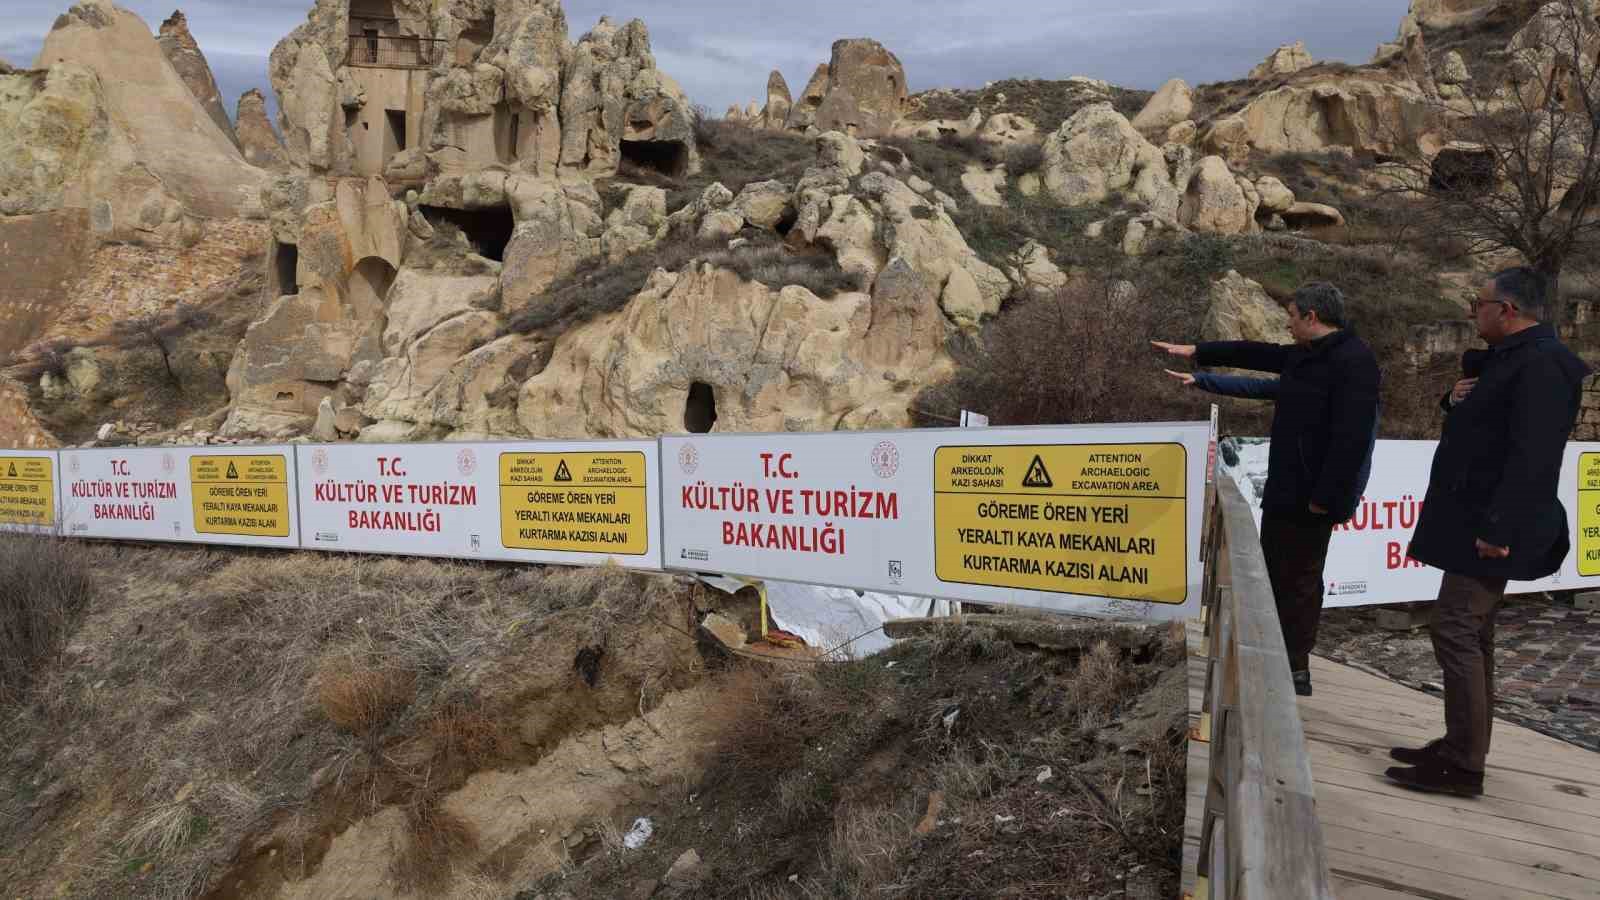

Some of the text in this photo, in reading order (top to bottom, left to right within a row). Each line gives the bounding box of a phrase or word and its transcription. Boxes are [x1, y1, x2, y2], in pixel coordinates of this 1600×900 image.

[110, 460, 131, 476] T.C.
[377, 457, 406, 476] T.C.
[760, 453, 799, 478] T.C.
[962, 453, 993, 464] DİKKAT
[1088, 453, 1142, 464] ATTENTION
[950, 465, 1004, 475] ARKEOLOJİK
[1080, 467, 1150, 478] ARCHAELOGIC
[71, 479, 177, 499] KÜLTÜR VE TURİZM
[315, 480, 477, 505] KÜLTÜR VE TURİZM
[951, 478, 1004, 488] KAZI SAHASI
[1071, 480, 1160, 492] EXCAVATION AREA
[527, 491, 616, 505] GÖREME ÖREN YERİ
[681, 481, 899, 520] KÜLTÜR VE TURİZM
[94, 502, 154, 521] BAKANLIĞI
[348, 508, 441, 532] BAKANLIĞI
[514, 510, 631, 525] YERALTI KAYA MEKANLARI
[977, 500, 1129, 524] GÖREME ÖREN YERİ
[519, 528, 628, 544] KURTARMA KAZISI ALANI
[722, 521, 845, 555] BAKANLIĞI
[958, 528, 1155, 555] YERALTI KAYA MEKANLARI
[963, 554, 1148, 585] KURTARMA KAZISI ALANI
